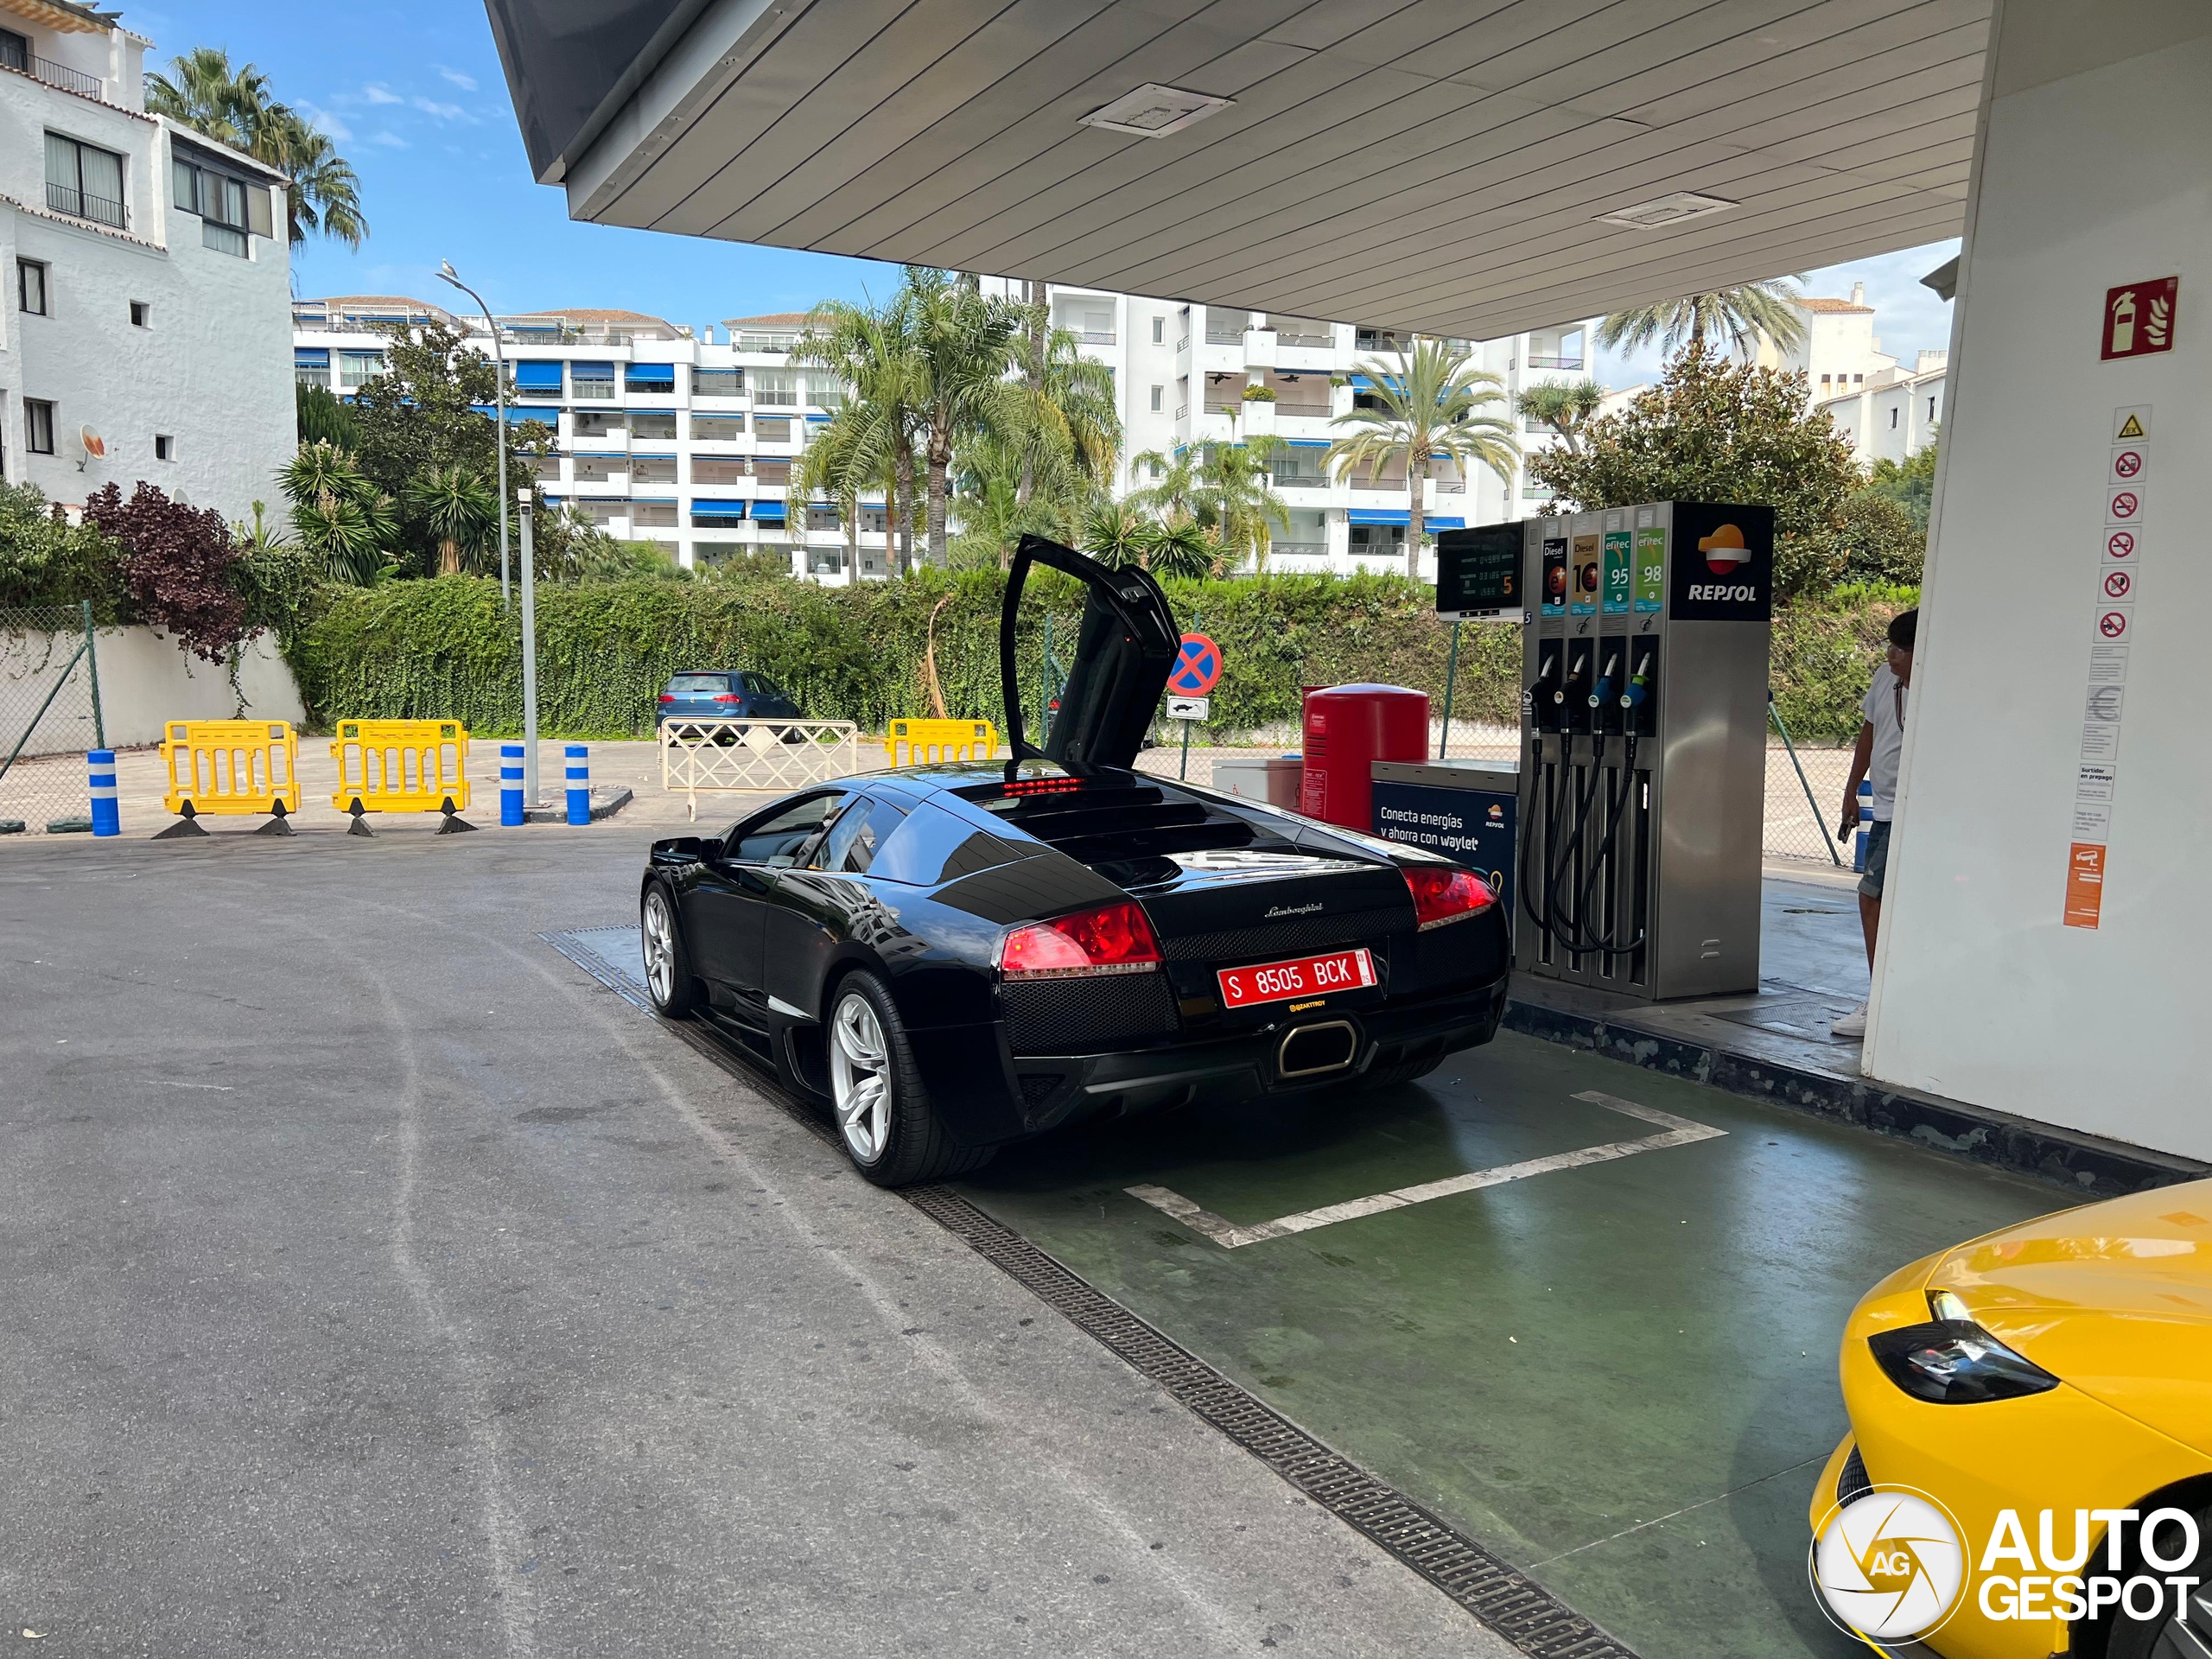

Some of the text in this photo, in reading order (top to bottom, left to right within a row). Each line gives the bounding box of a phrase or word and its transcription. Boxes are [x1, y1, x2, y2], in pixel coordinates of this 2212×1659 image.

[1574, 543, 1594, 553] Diesel
[1605, 540, 1630, 550] efitec
[1638, 537, 1663, 547] efitec
[1544, 545, 1563, 556] Diesel
[1611, 568, 1629, 585] 95
[1643, 565, 1662, 582] 98
[1503, 575, 1513, 594] 5
[1688, 584, 1757, 601] REPSOL
[1524, 612, 1532, 624] 5
[1381, 806, 1463, 830] Conecta energías
[1388, 826, 1418, 842] ahorra
[1420, 833, 1438, 845] con
[1440, 835, 1478, 852] waylet
[1264, 902, 1324, 918] Lamborghini
[1228, 957, 1352, 999] S 8505 BCK
[1361, 975, 1370, 984] 25
